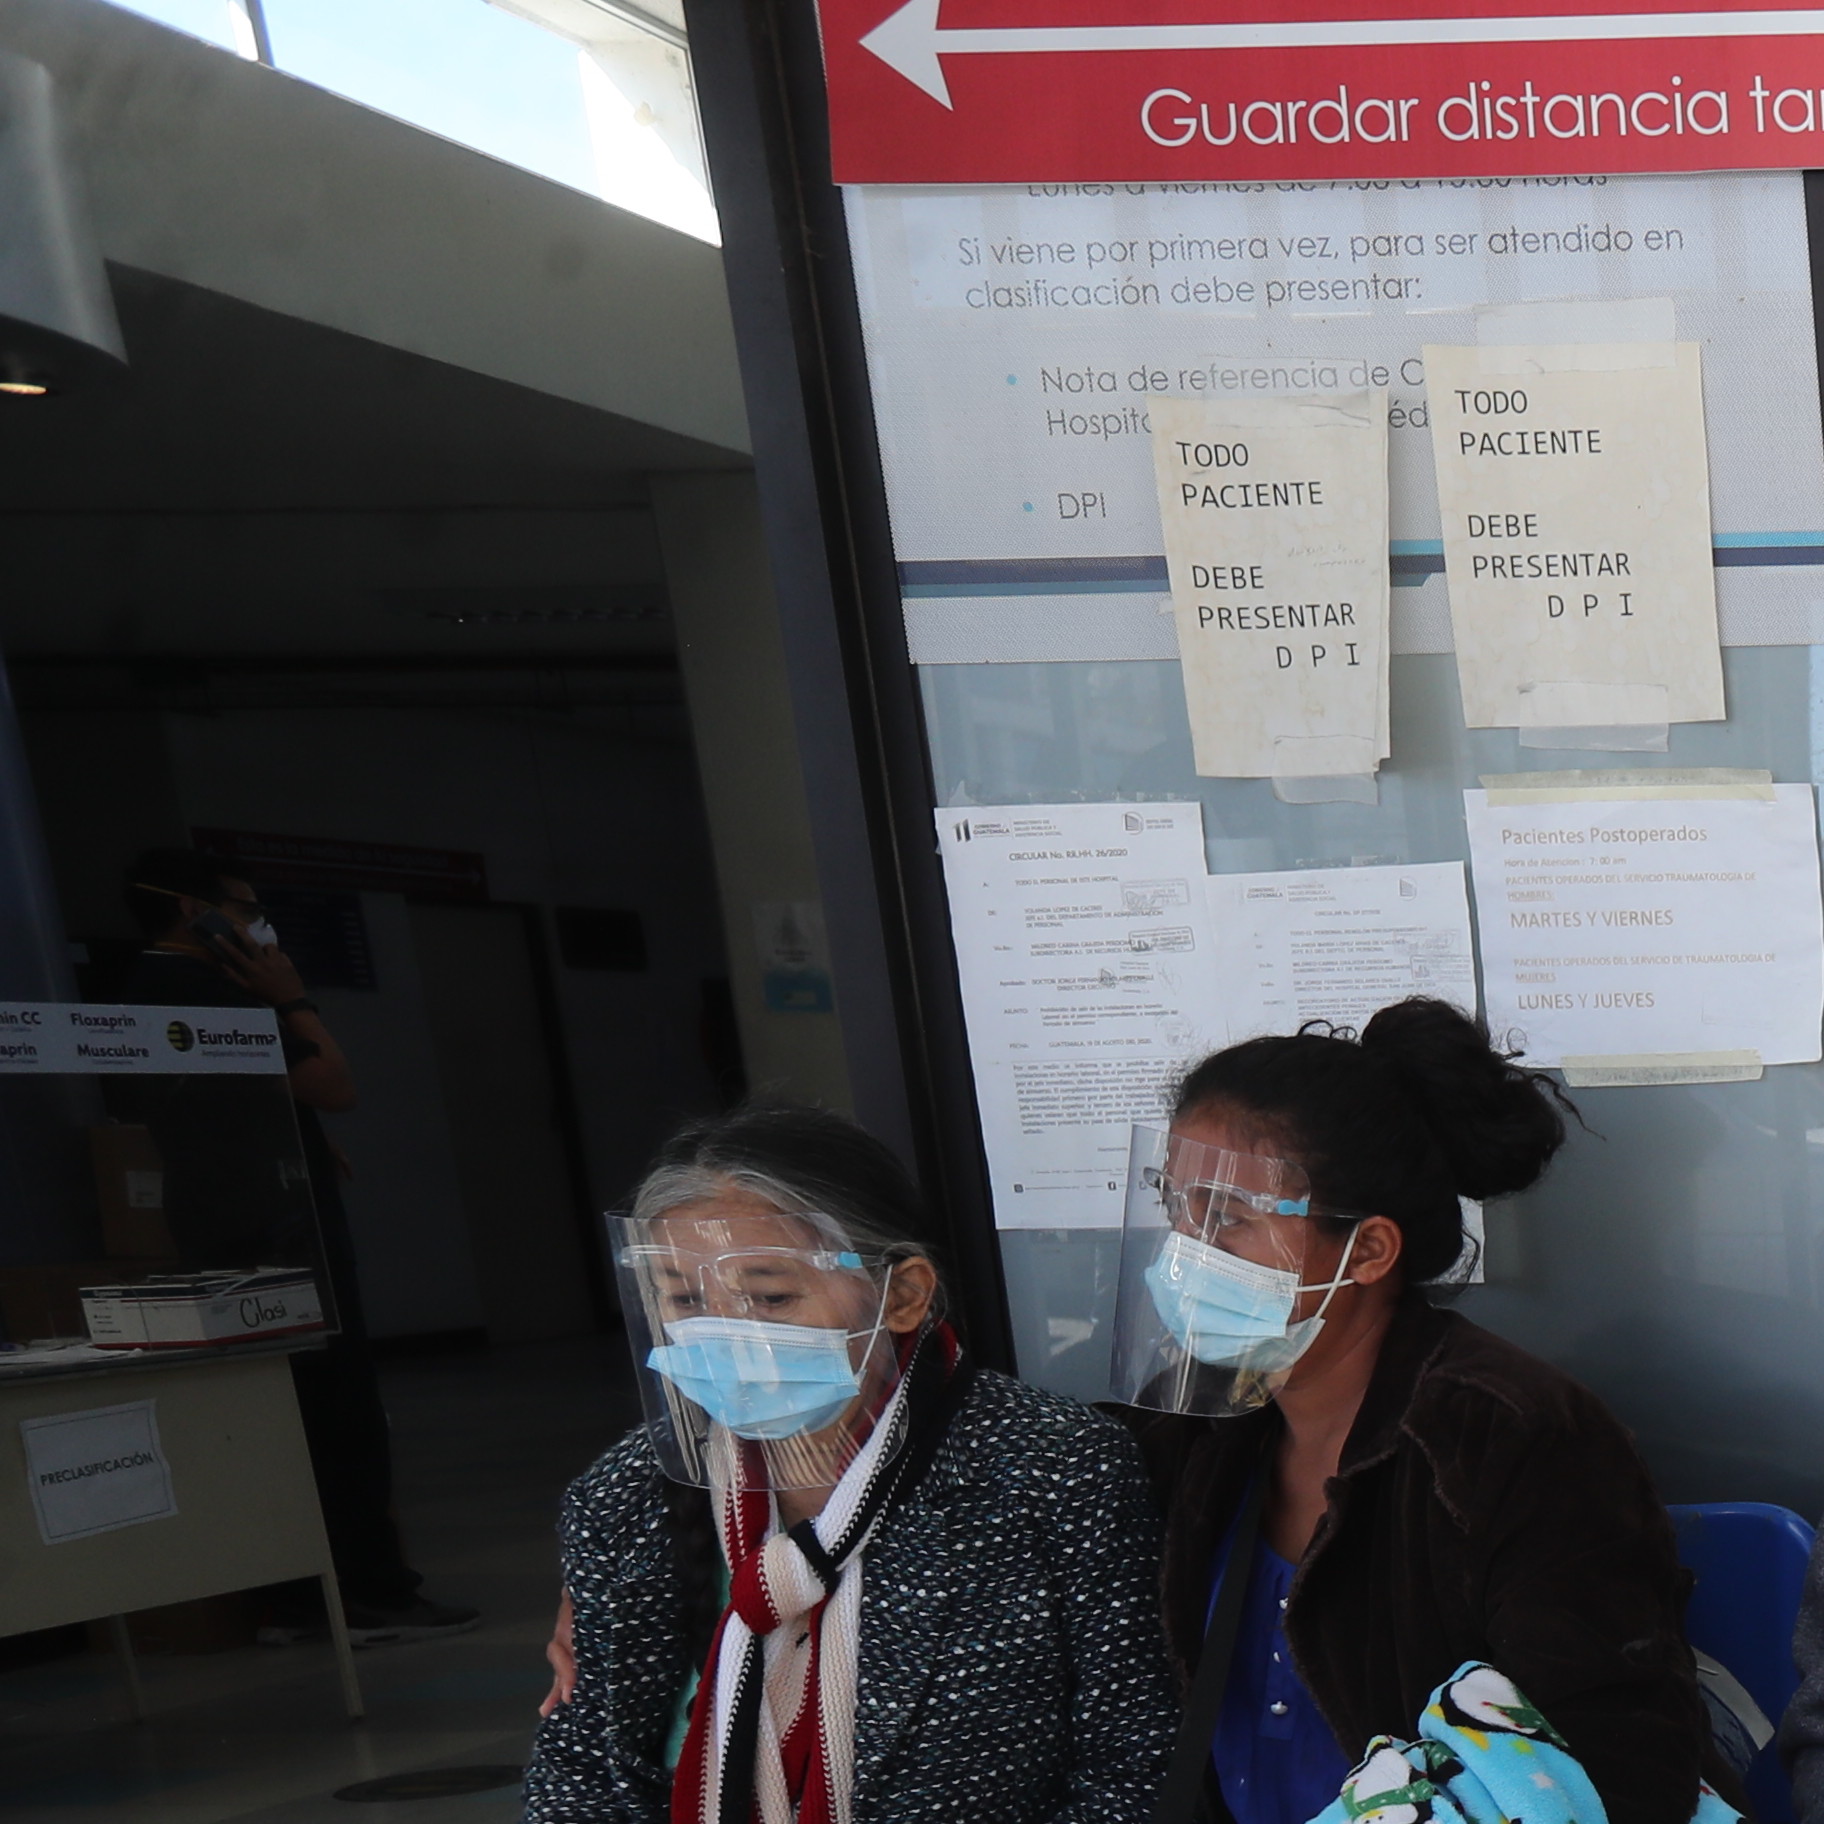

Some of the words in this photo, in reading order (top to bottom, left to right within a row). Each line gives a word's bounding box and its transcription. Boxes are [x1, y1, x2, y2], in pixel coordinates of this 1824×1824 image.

[1140, 84, 1420, 148] Guardar
[1437, 75, 1729, 143] distancia
[957, 232, 982, 265] Si
[989, 233, 1078, 267] viene
[1087, 236, 1142, 273] por
[1147, 231, 1270, 272] primera
[1277, 234, 1342, 266] vez,
[1348, 232, 1425, 268] para
[1433, 231, 1479, 257] ser
[1487, 221, 1634, 258] atendido
[1642, 226, 1685, 252] en
[965, 272, 1162, 310] clasificación
[1170, 272, 1256, 307] debe
[1264, 270, 1425, 309] presentar:
[1041, 362, 1118, 394] Nota
[1128, 361, 1172, 394] de
[1178, 359, 1341, 393] referencia
[1350, 356, 1393, 389] de
[1456, 388, 1529, 415] TODO
[1175, 441, 1250, 468] TODO
[1460, 427, 1603, 457] PACIENTE
[1058, 491, 1107, 521] DPI
[1180, 480, 1325, 509] PACIENTE
[1467, 512, 1539, 539] DEBE
[1192, 562, 1266, 591] DEBE
[1471, 550, 1632, 579] PRESENTAR
[1197, 600, 1357, 630] PRESENTAR
[1502, 828, 1585, 845] Pacientes
[1590, 825, 1708, 846] Postoperados
[1009, 852, 1048, 861] CIRCULAR
[1504, 858, 1525, 868] Hora
[1526, 857, 1538, 867] de
[1613, 857, 1627, 866] am
[1506, 875, 1554, 885] PACIENTES
[1556, 874, 1603, 885] OPERADOS
[1605, 874, 1621, 884] DEL
[1624, 873, 1663, 883] SERVICIO
[1665, 872, 1742, 883] TRAUMATOLOGIA
[1744, 872, 1756, 881] DE
[1511, 911, 1582, 929] MARTES
[1586, 911, 1599, 927] Y
[1601, 910, 1674, 927] VIERNES
[1514, 957, 1561, 967] PACIENTES
[1563, 957, 1611, 967] OPERADOS
[1613, 956, 1629, 966] DEL
[1630, 955, 1671, 965] SERVICIO
[1673, 955, 1684, 964] DE
[1685, 954, 1763, 964] TRAUMATOLOGIA
[1765, 953, 1776, 962] DE
[1515, 972, 1556, 983] MUJERES
[1517, 993, 1574, 1010] LUNES
[1578, 993, 1590, 1009] Y
[1593, 991, 1655, 1008] JUEVES
[21, 1011, 42, 1026] CC
[71, 1013, 137, 1029] Floxaprin
[77, 1044, 150, 1058] Musculare
[239, 1298, 287, 1328] Clasi
[40, 1451, 154, 1487] PRECLASIFICACIÓN
